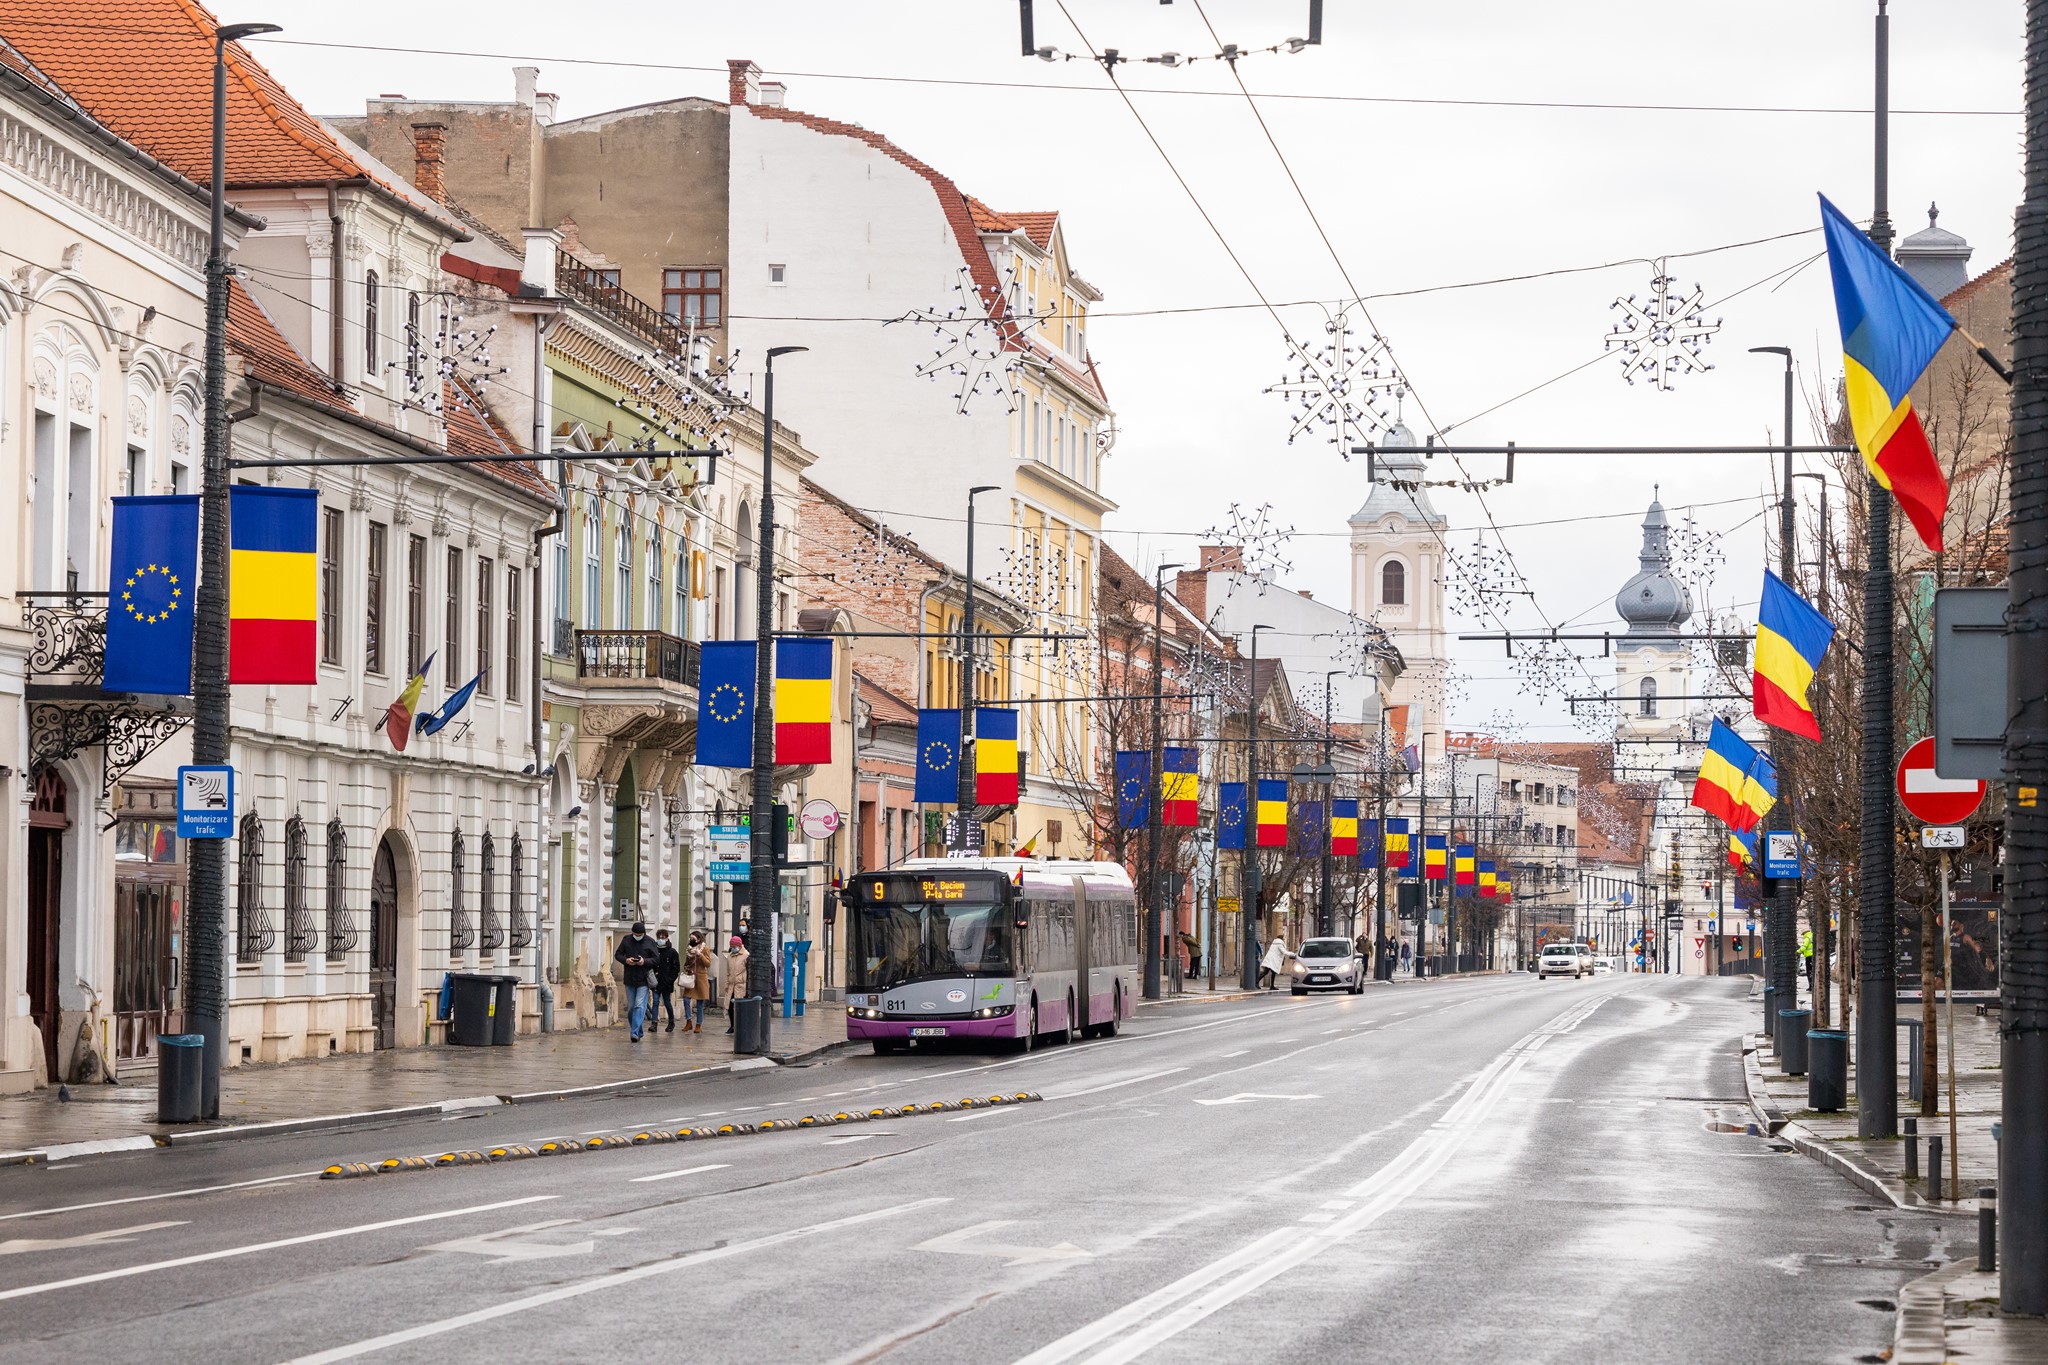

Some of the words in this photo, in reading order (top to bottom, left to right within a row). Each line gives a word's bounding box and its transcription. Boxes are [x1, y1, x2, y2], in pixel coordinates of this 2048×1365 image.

[183, 815, 228, 823] Monitorizare
[195, 826, 216, 834] trafic
[874, 881, 884, 899] 9
[922, 881, 938, 890] Str.
[887, 1000, 906, 1011] 811
